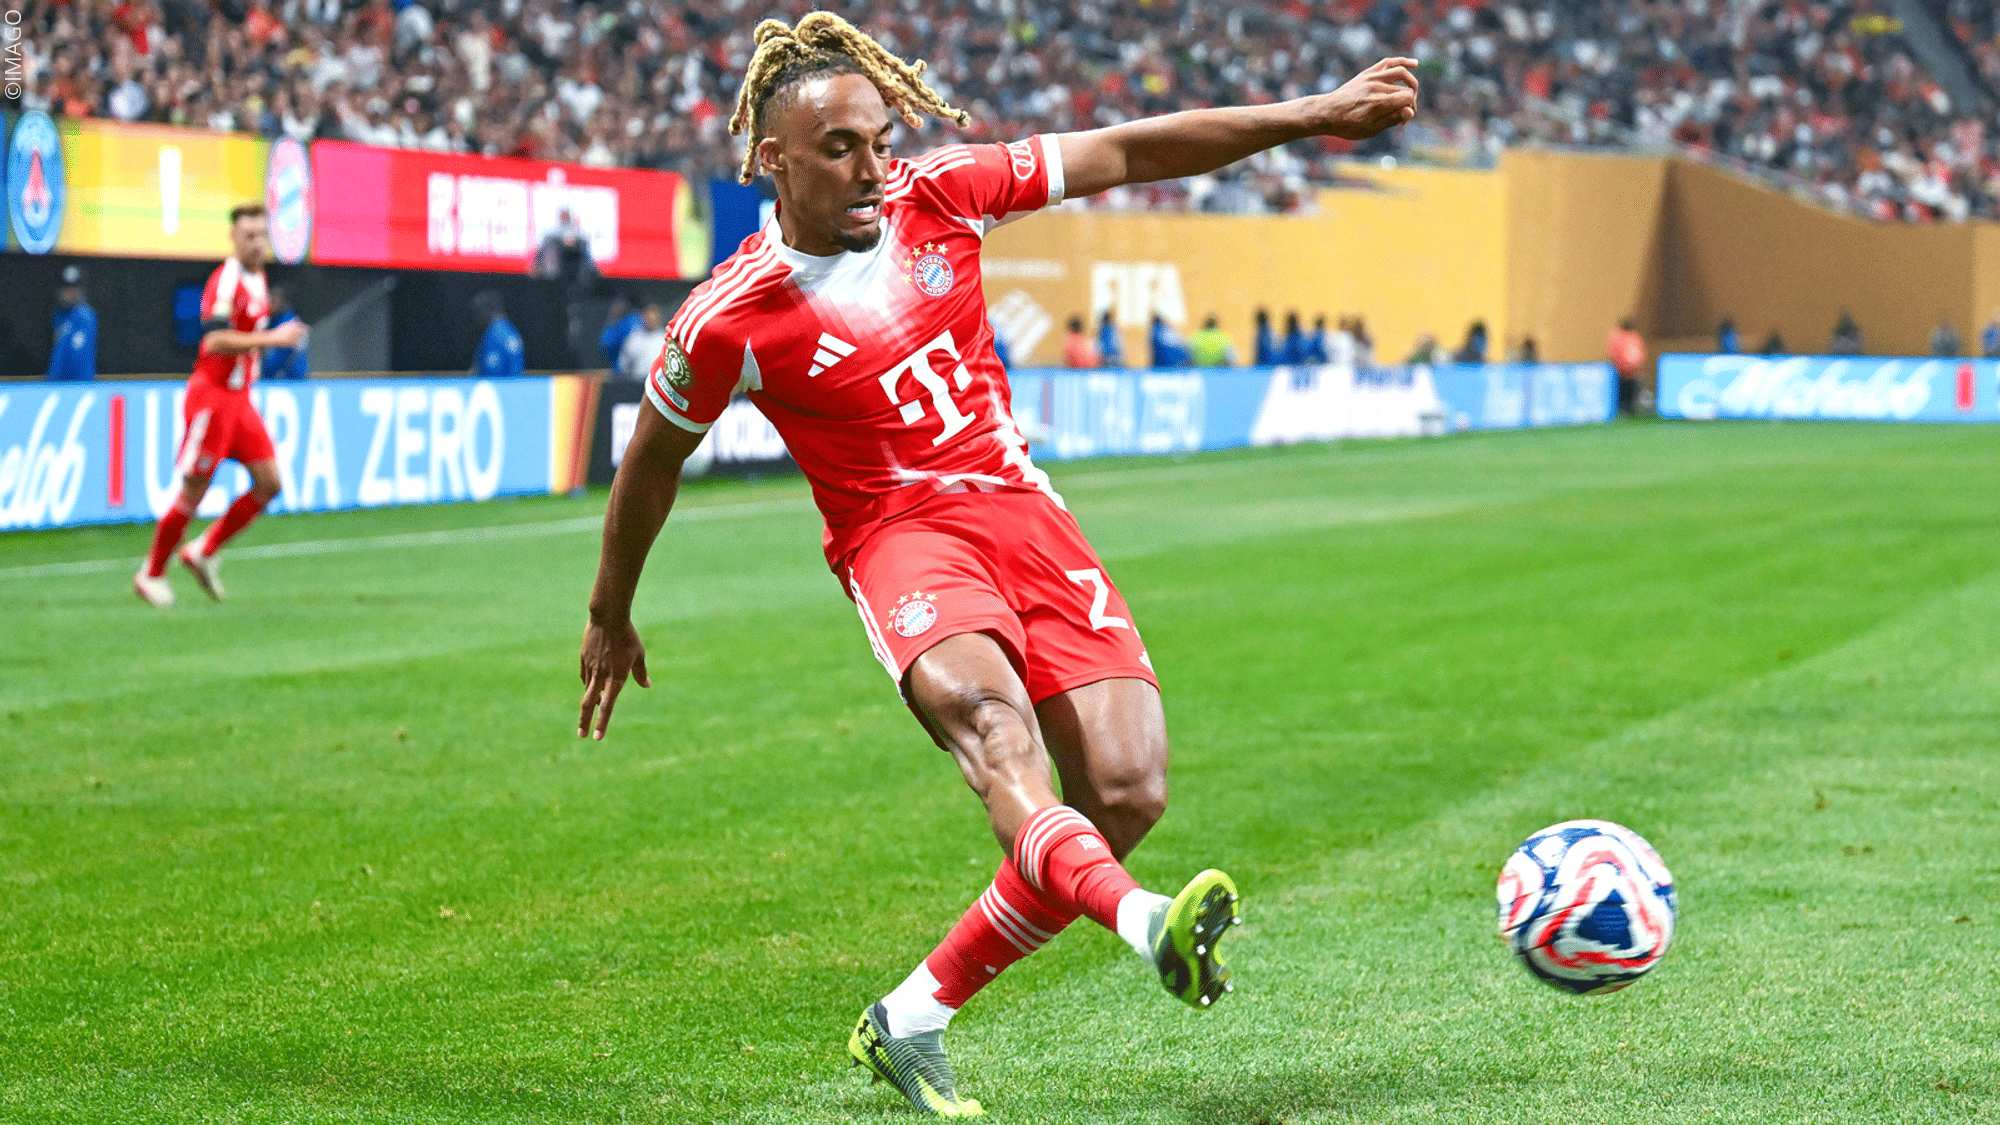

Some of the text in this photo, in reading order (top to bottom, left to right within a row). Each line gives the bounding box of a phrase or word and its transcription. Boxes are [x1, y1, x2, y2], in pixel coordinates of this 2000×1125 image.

[1091, 261, 1187, 325] FIFA
[144, 387, 340, 519] URA
[357, 381, 505, 505] ZERO
